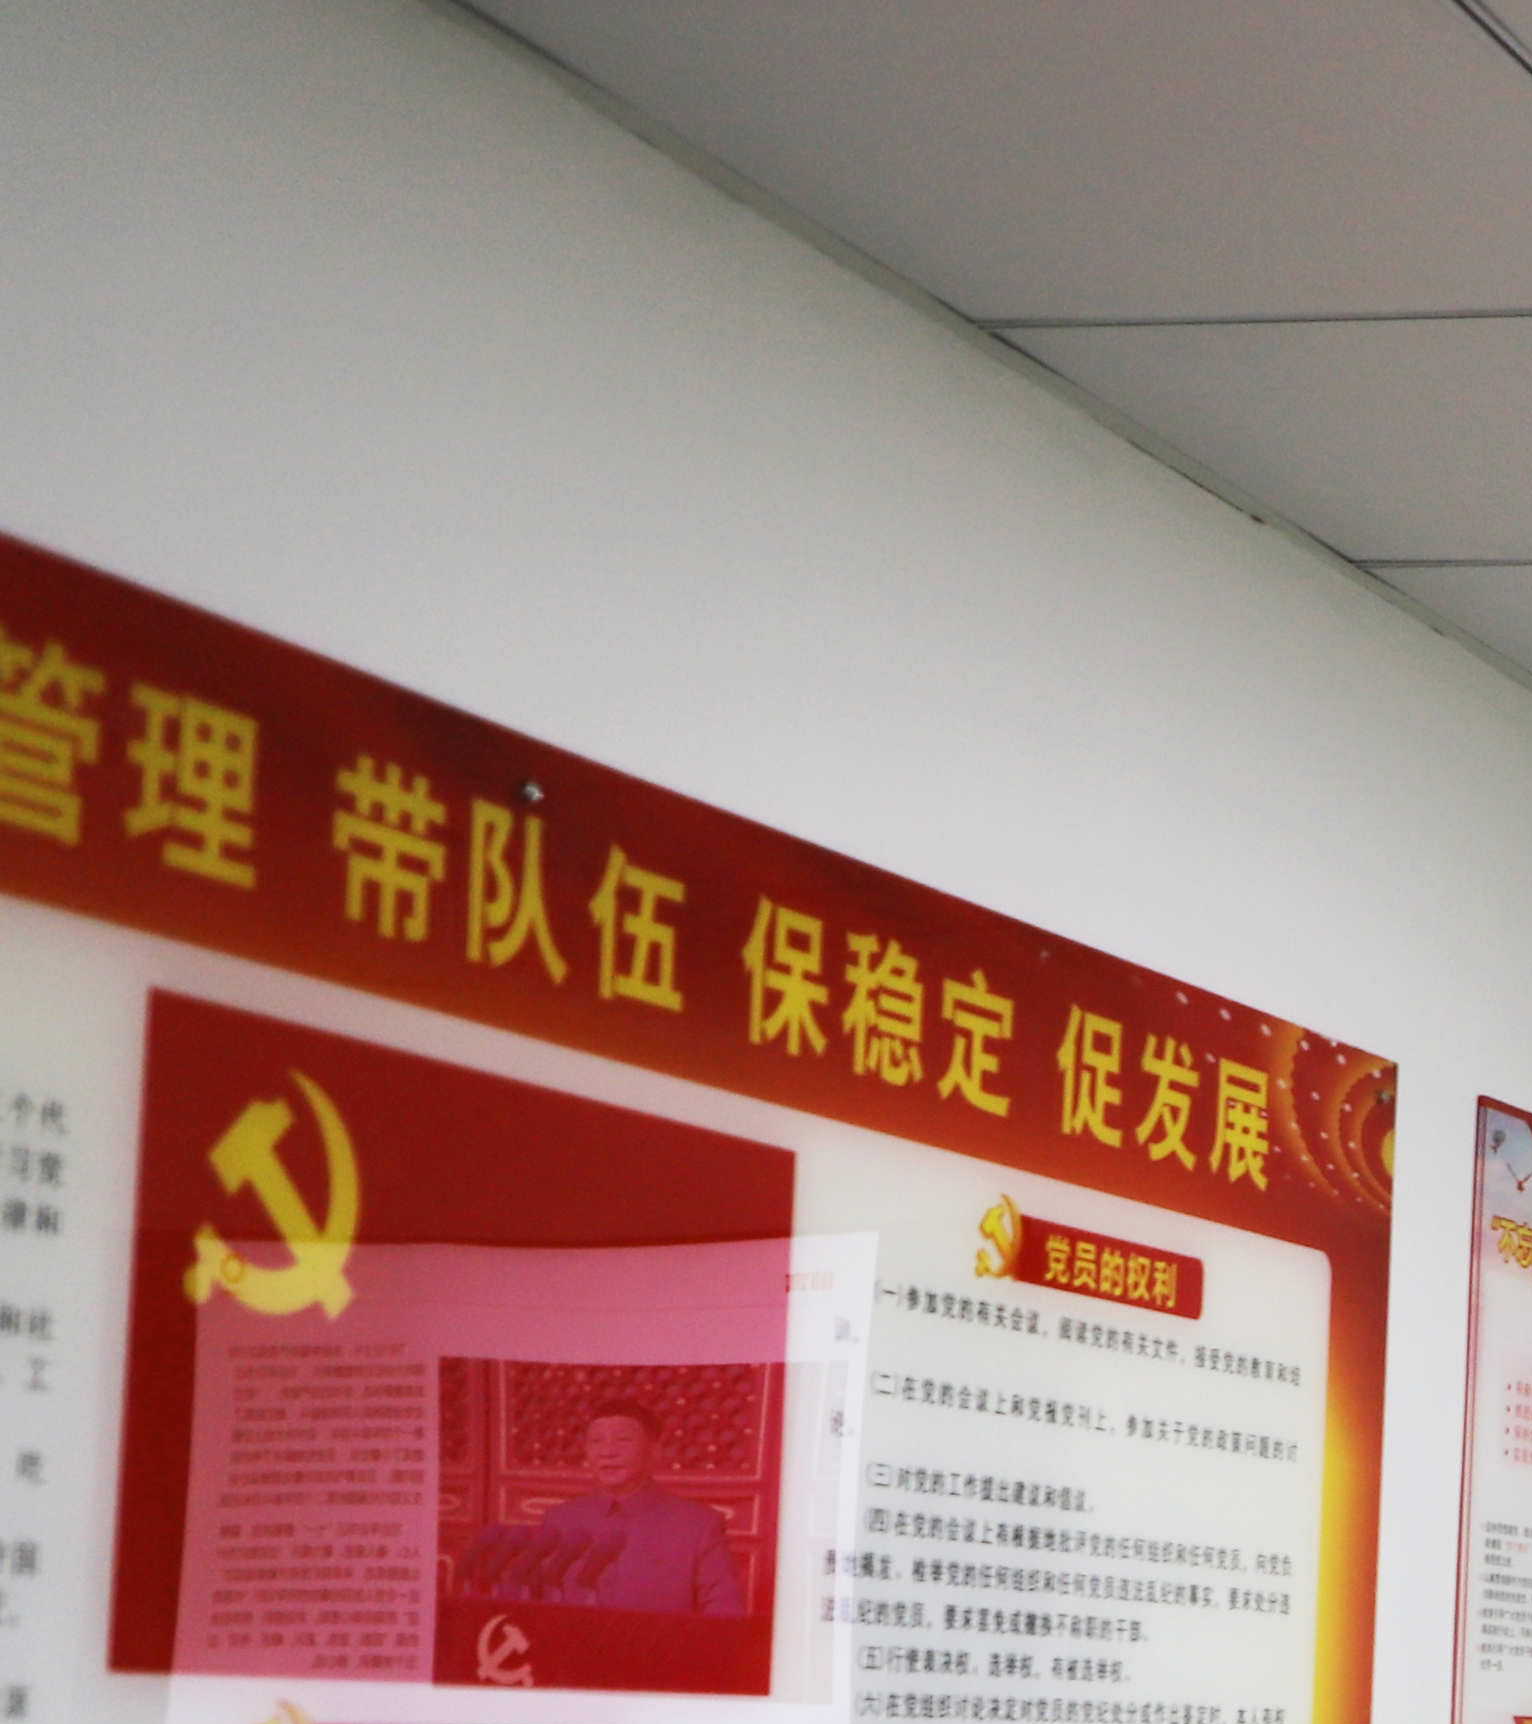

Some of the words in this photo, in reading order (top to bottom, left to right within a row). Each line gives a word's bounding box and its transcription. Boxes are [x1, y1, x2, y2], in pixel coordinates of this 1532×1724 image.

[0, 625, 258, 889] 管理
[333, 755, 686, 1011] 带队伍
[742, 895, 1013, 1117] 保稳定
[1057, 1005, 1269, 1190] 促发展
[1044, 1234, 1177, 1306] 党员的权利
